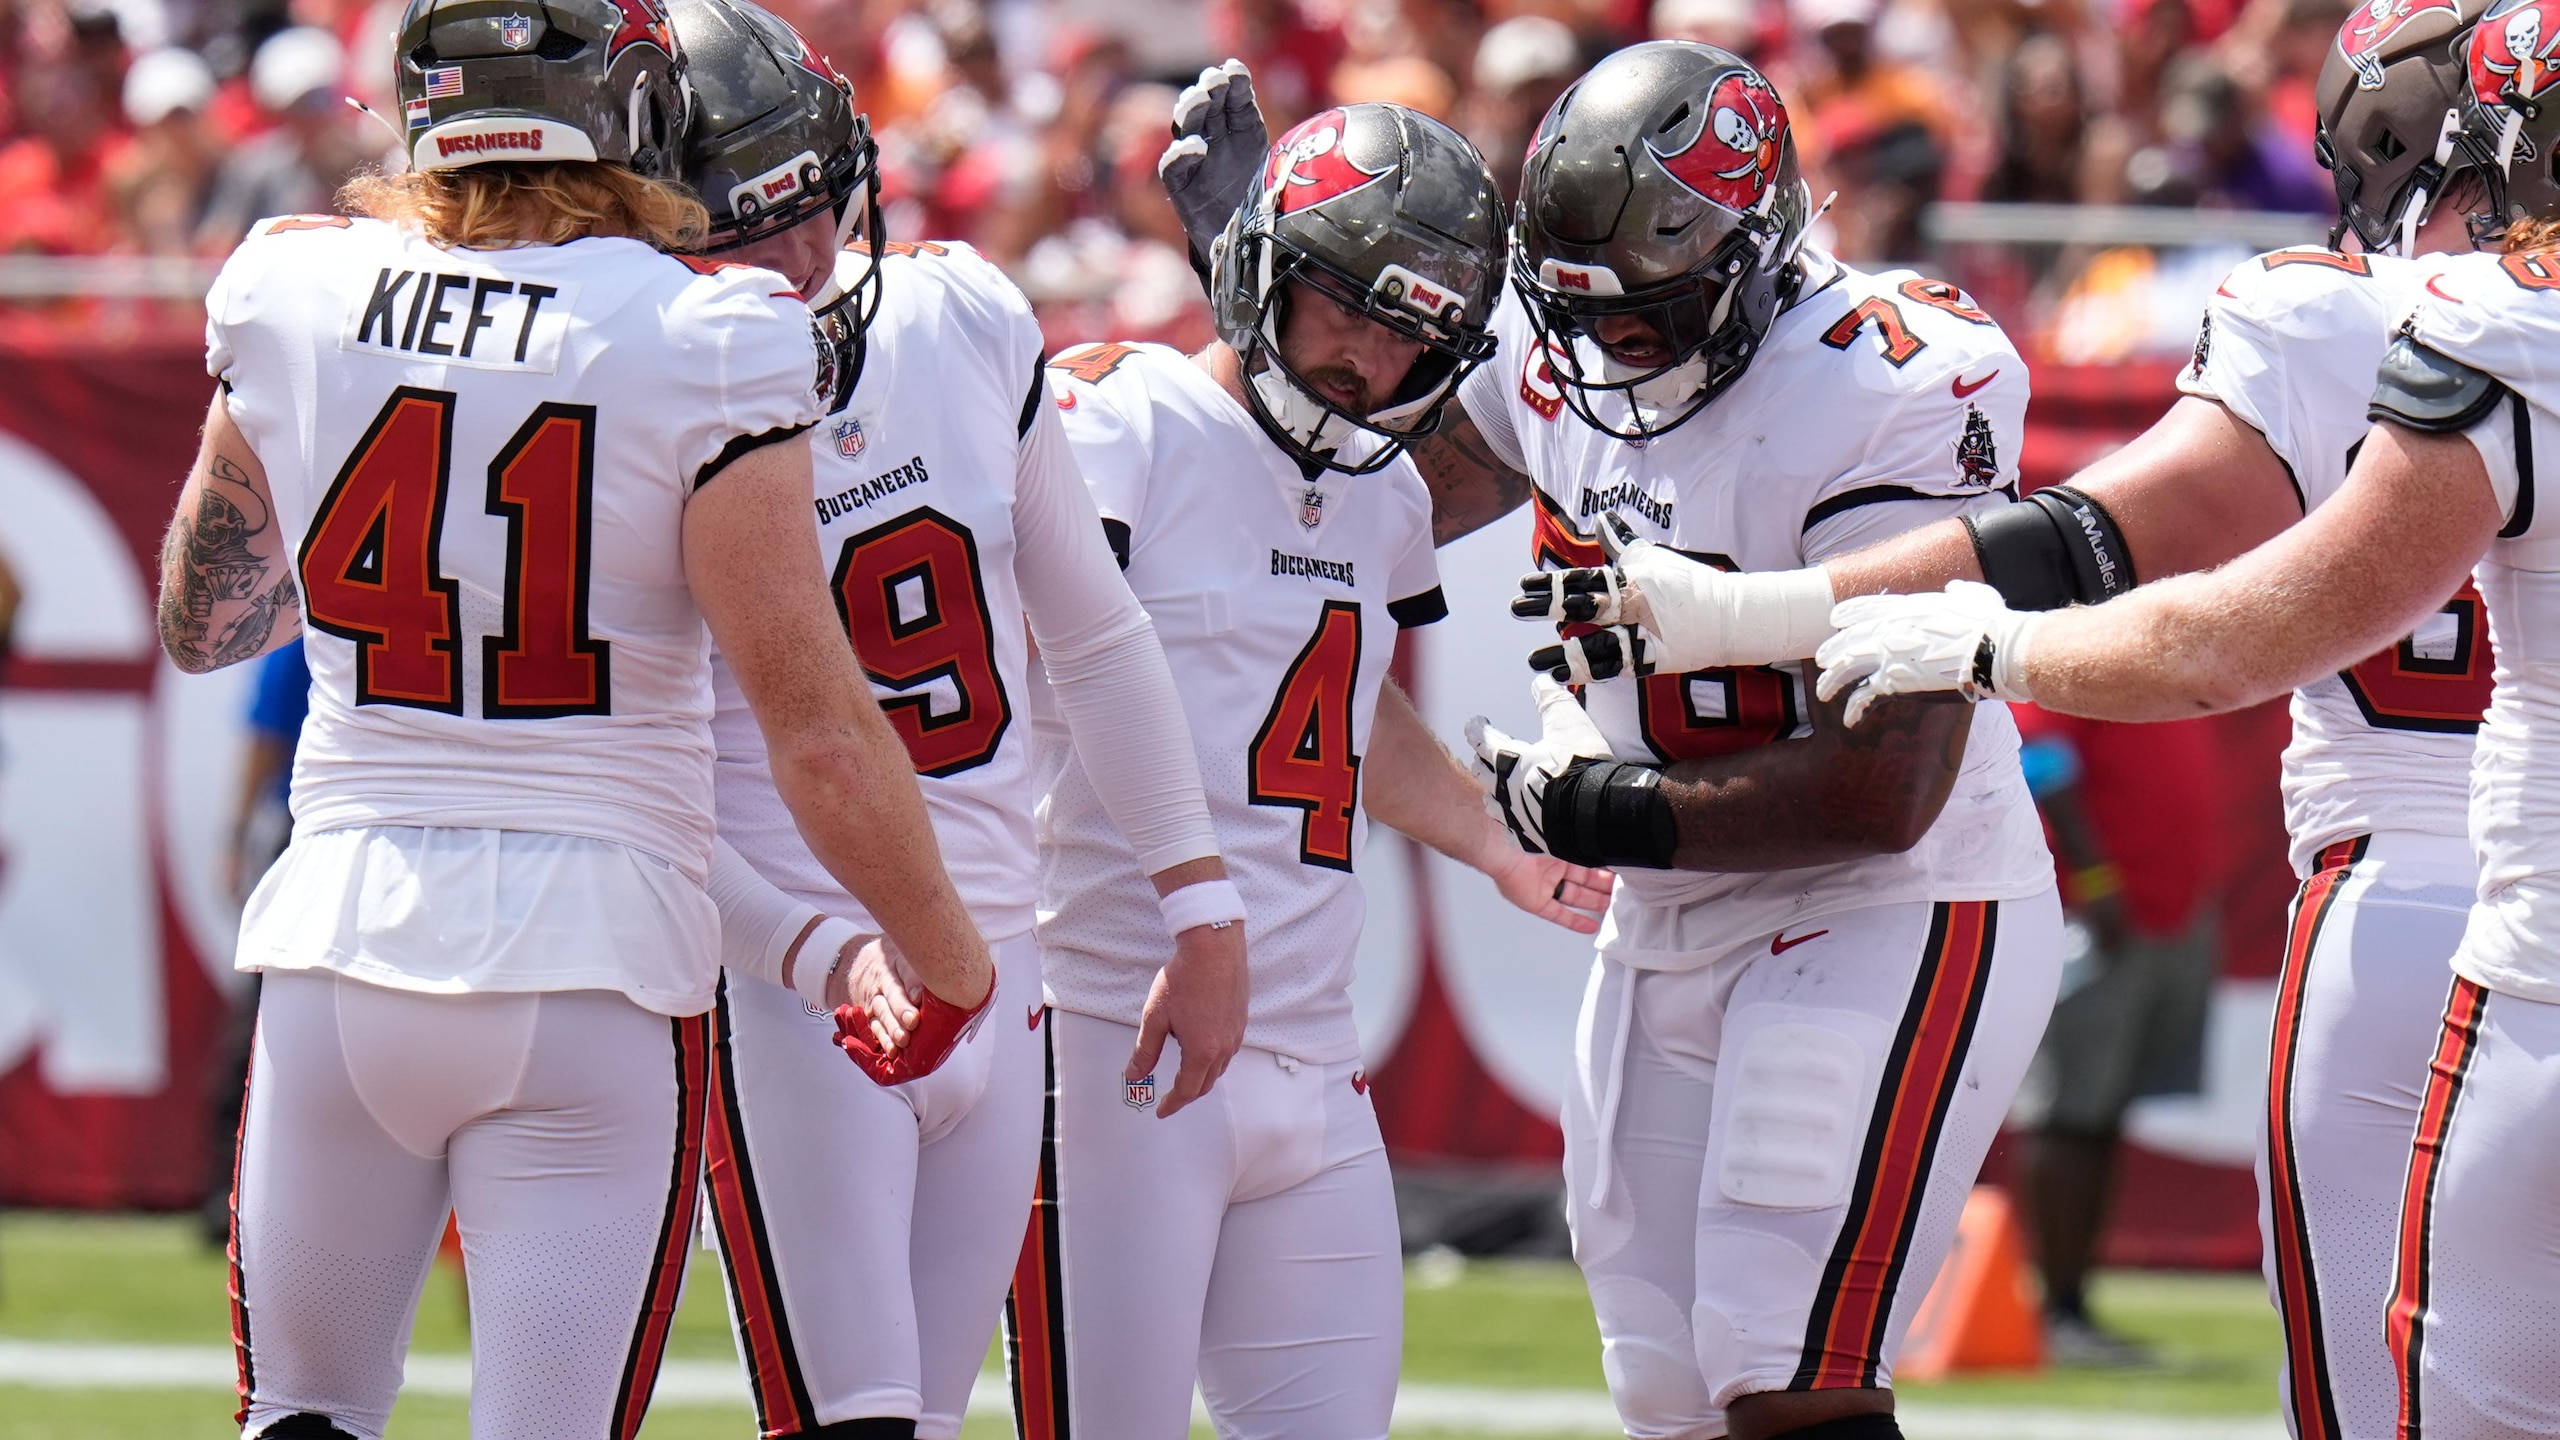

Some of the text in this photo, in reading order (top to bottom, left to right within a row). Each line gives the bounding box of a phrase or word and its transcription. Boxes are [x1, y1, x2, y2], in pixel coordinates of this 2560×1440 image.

[505, 28, 528, 43] NFL
[357, 268, 558, 362] KIEFT
[841, 433, 864, 454] NFL
[814, 455, 929, 526] BUCCANEERS
[1304, 506, 1321, 524] NFL
[1580, 481, 1673, 530] BUCCANEERS
[297, 385, 611, 719] 41
[1271, 548, 1355, 588] BUCCANEERS
[2082, 515, 2117, 590] Mueller
[830, 505, 1012, 779] 9
[1248, 599, 1362, 874] 4
[1129, 1086, 1152, 1103] NFL
